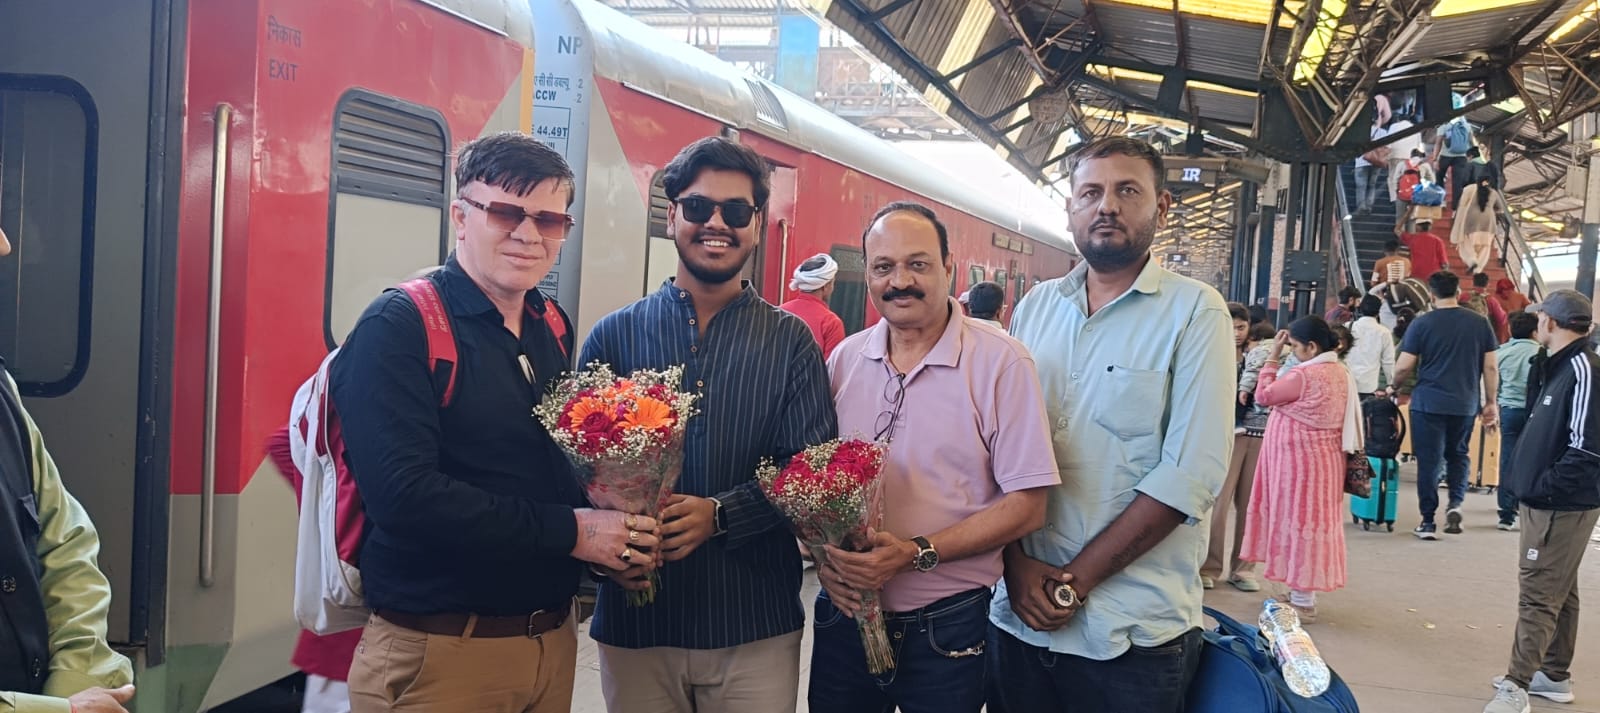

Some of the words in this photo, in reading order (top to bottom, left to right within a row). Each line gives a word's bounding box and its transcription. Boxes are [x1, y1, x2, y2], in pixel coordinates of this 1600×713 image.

[267, 15, 302, 49] निकास
[269, 59, 298, 82] EXIT
[533, 89, 557, 101] CCW
[537, 125, 568, 137] 44.49T
[1182, 167, 1201, 182] IR
